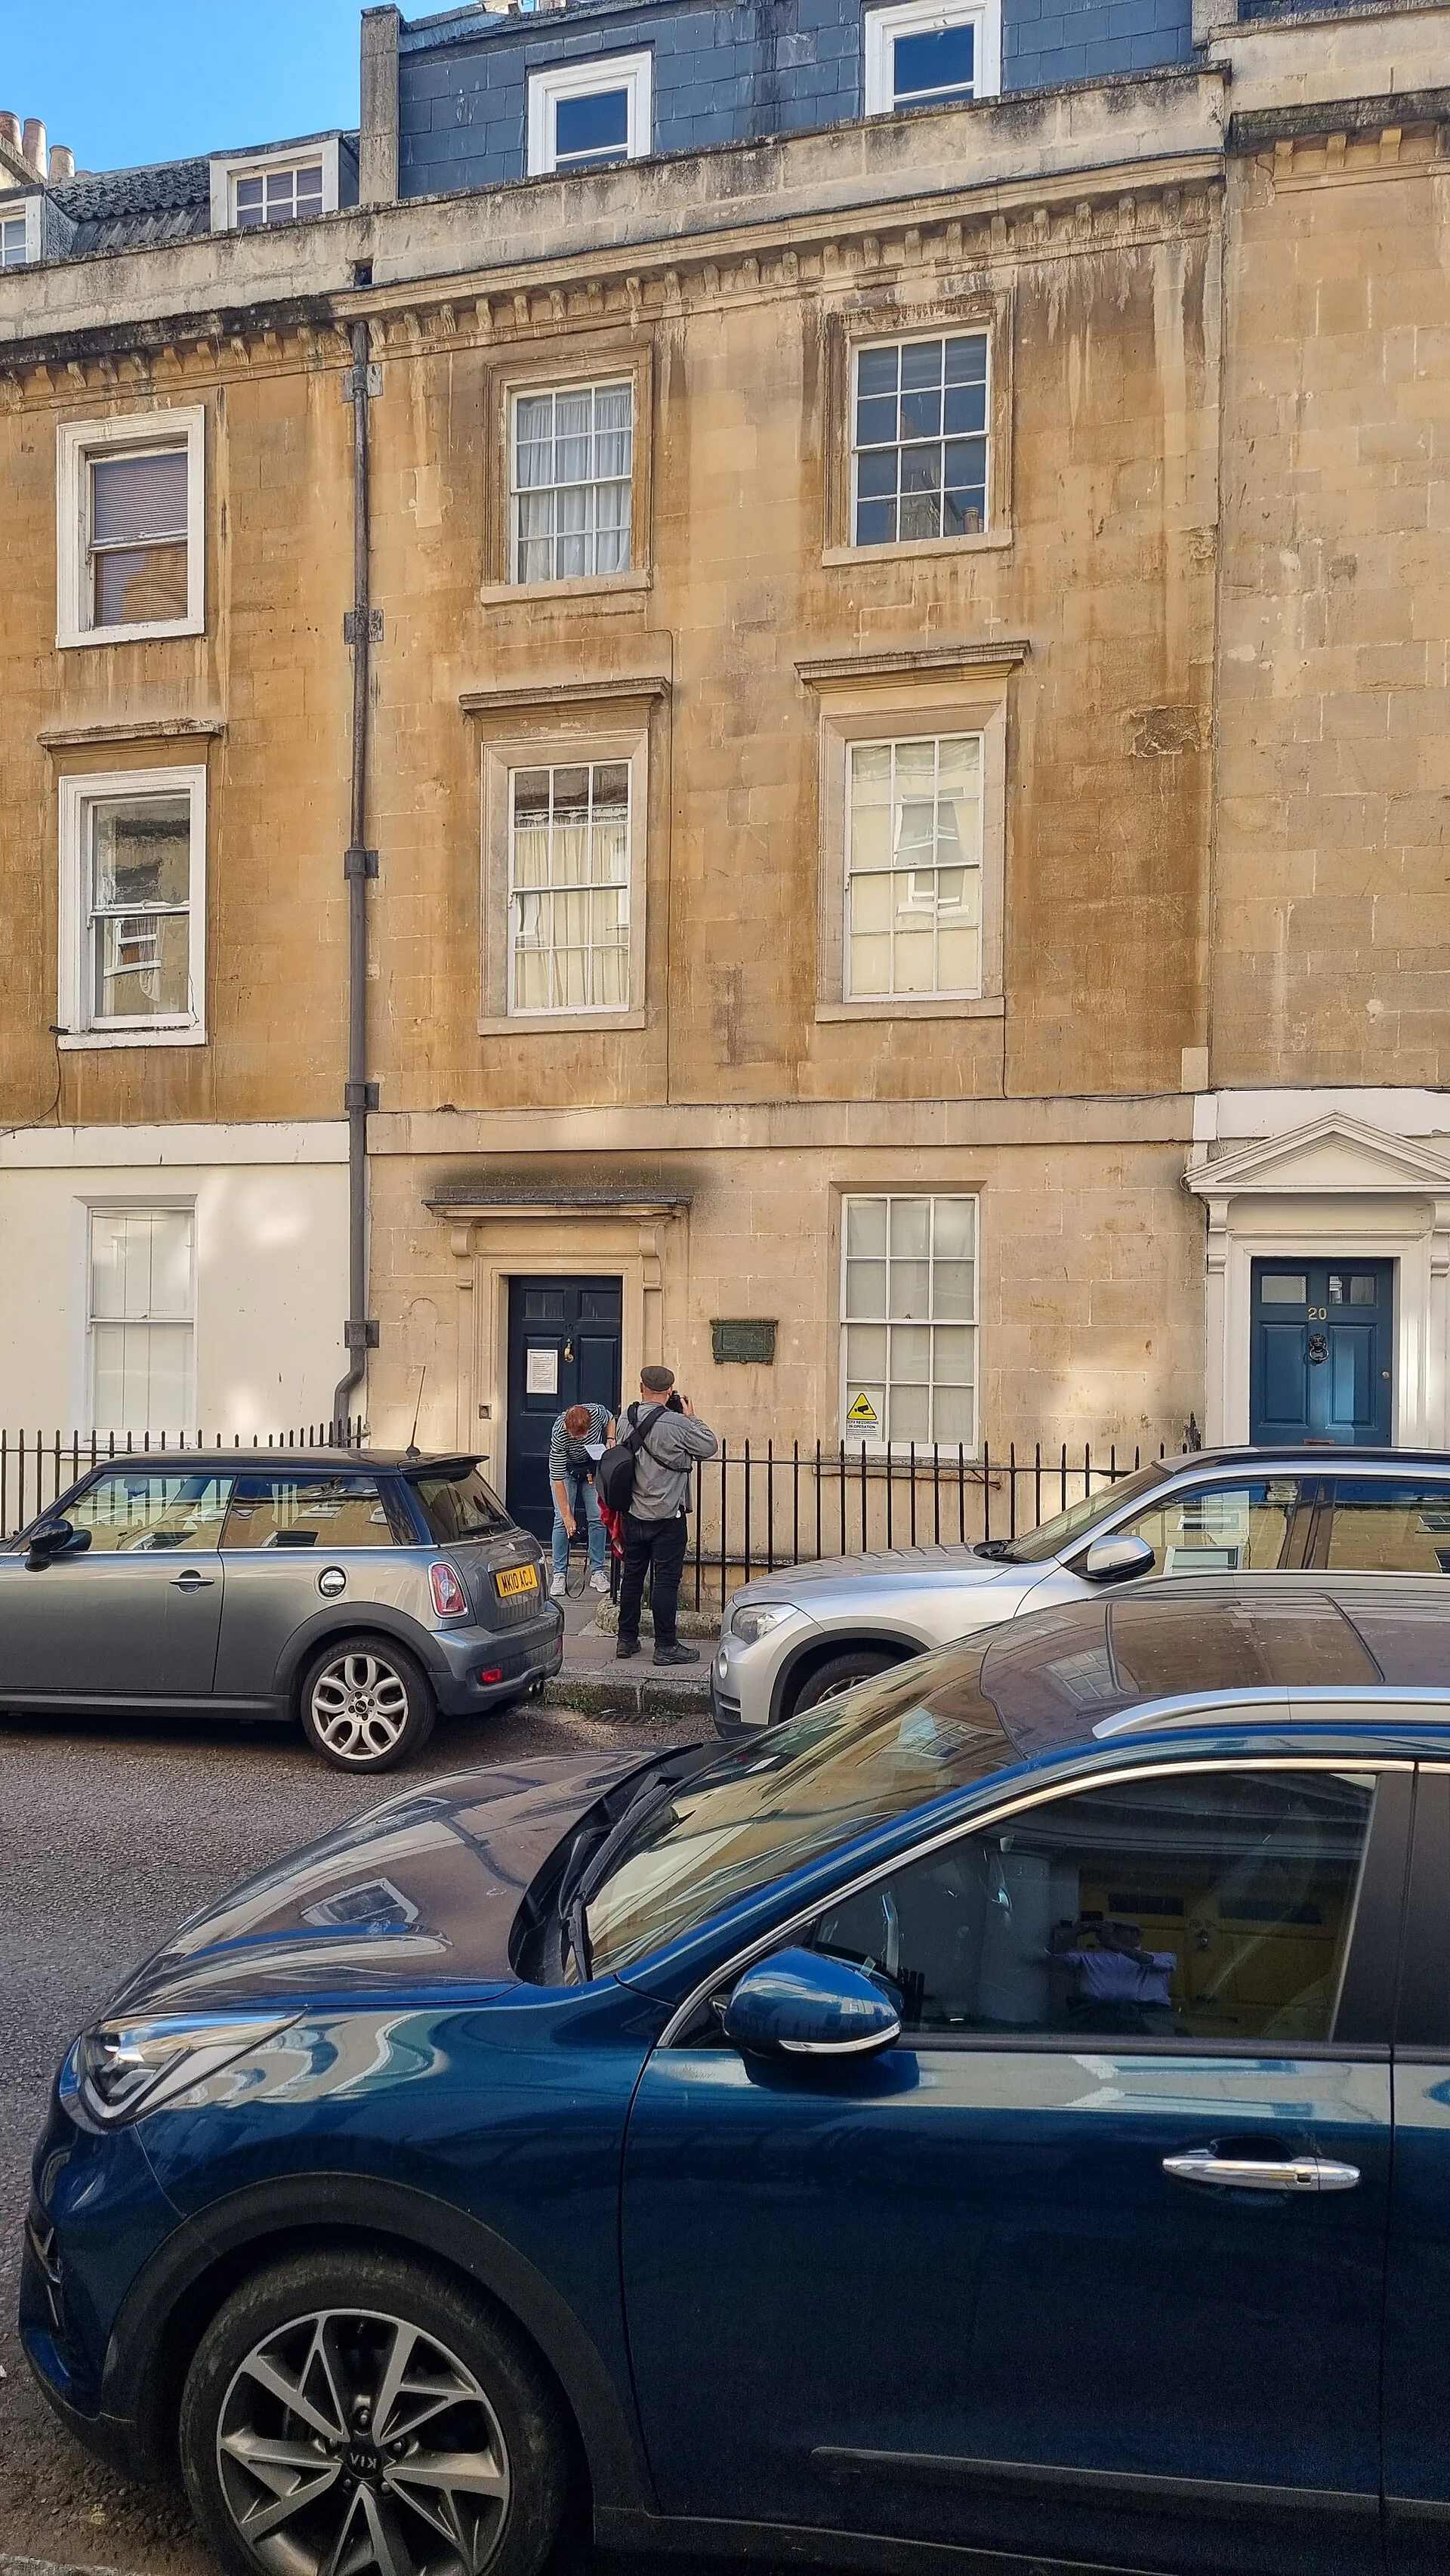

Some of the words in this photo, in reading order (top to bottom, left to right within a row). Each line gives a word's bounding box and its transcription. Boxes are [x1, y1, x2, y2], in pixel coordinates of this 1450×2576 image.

[1307, 1307, 1327, 1320] 20
[520, 1568, 533, 1588] ACJ
[350, 2452, 377, 2470] KIA
